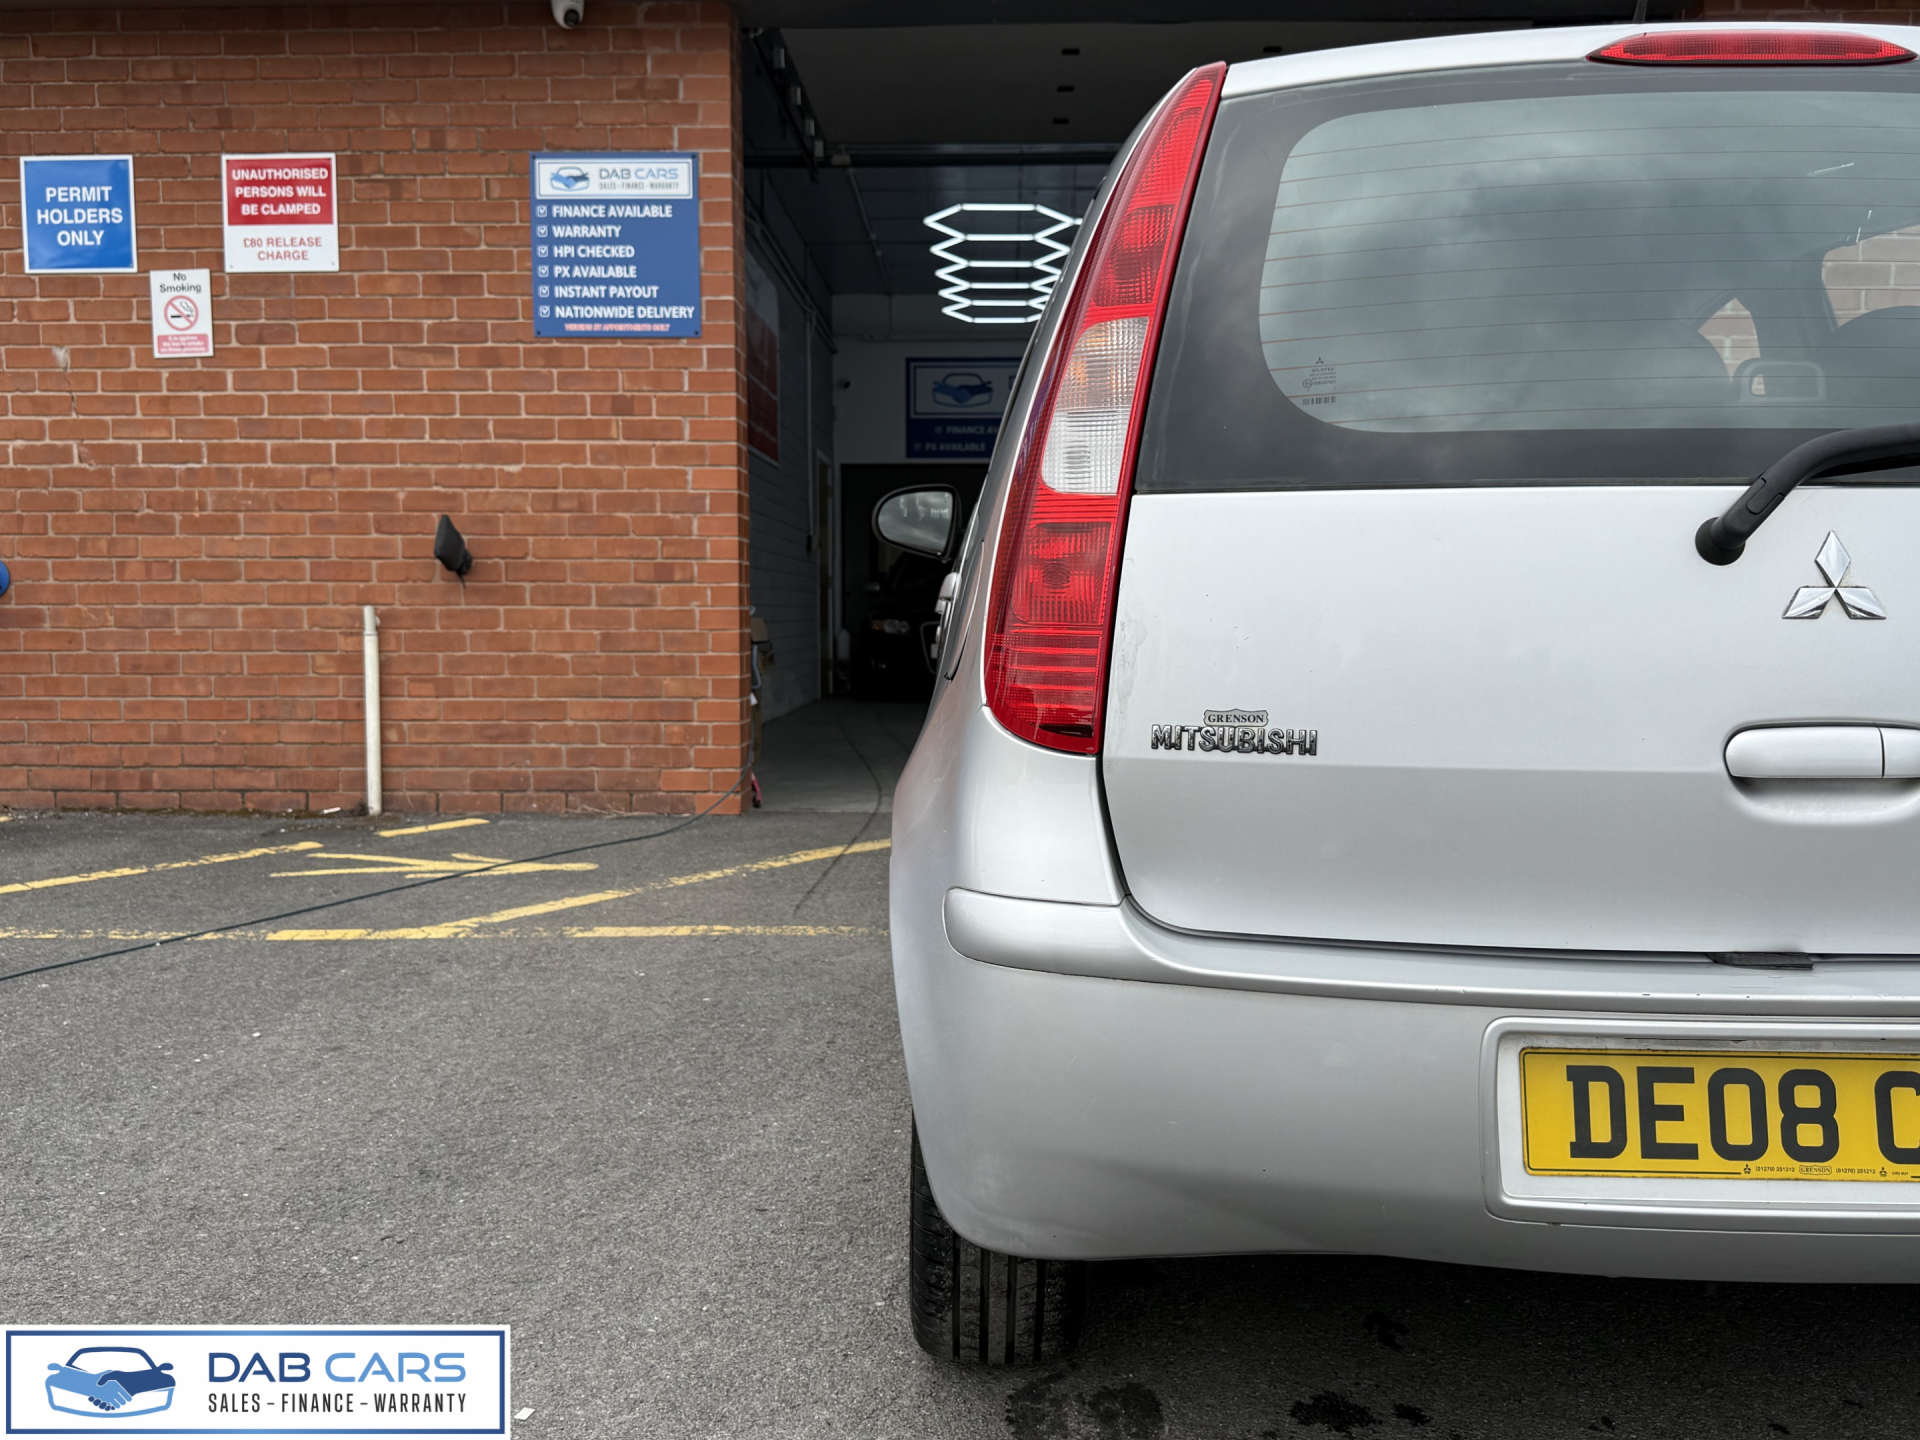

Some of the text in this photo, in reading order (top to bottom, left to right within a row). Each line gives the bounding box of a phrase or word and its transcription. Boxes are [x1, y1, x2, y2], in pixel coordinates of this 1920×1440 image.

[232, 168, 328, 181] UNAUTHORISED
[600, 168, 678, 179] DAB CARS
[45, 186, 112, 202] PERMIT
[235, 185, 326, 198] PERSONS WILL
[242, 203, 321, 215] BE CLAMPED
[553, 205, 672, 218] FINANCE AVAILABLE
[37, 208, 123, 224] HOLDERS
[553, 225, 622, 238] WARRANTY
[57, 230, 104, 246] ONLY
[267, 237, 322, 248] RELEASE
[258, 250, 309, 261] CHARGE
[553, 245, 635, 258] HPI CHECKED
[173, 272, 187, 282] No
[554, 266, 637, 278] PX AVAILABLE
[160, 282, 202, 294] Smoking
[555, 286, 659, 298] INSTANT PAYOUT
[555, 306, 695, 318] NATIONWIDE DELIVERY
[1207, 714, 1264, 723] GRENSON
[1151, 725, 1318, 756] MITSUBISHI
[1566, 1065, 1840, 1162] DE08
